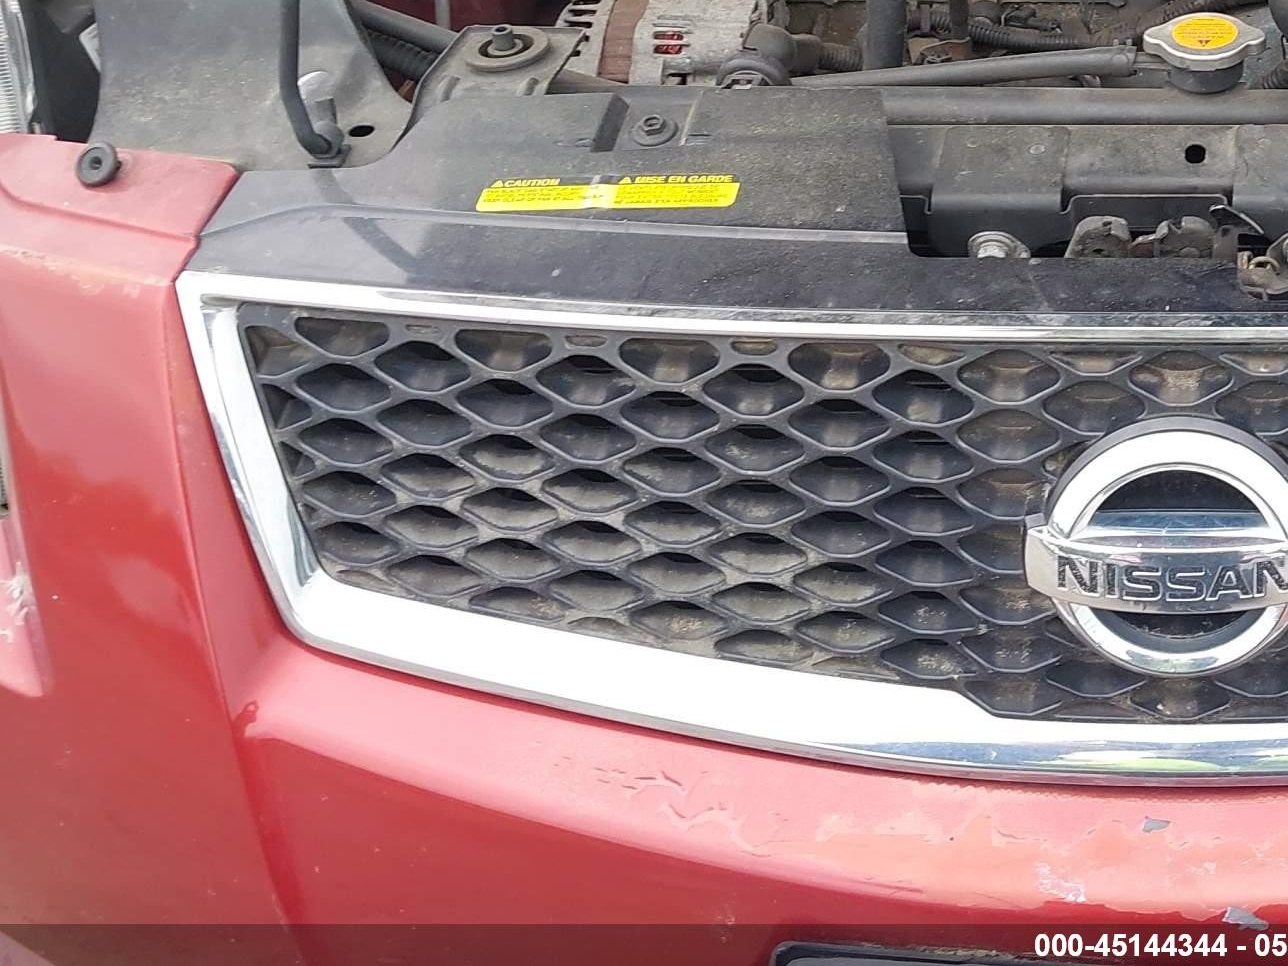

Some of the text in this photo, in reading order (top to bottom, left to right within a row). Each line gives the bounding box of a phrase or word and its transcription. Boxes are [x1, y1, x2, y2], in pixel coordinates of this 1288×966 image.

[504, 178, 561, 187] CAUTION
[634, 176, 666, 184] MISE
[687, 175, 734, 183] GARDE
